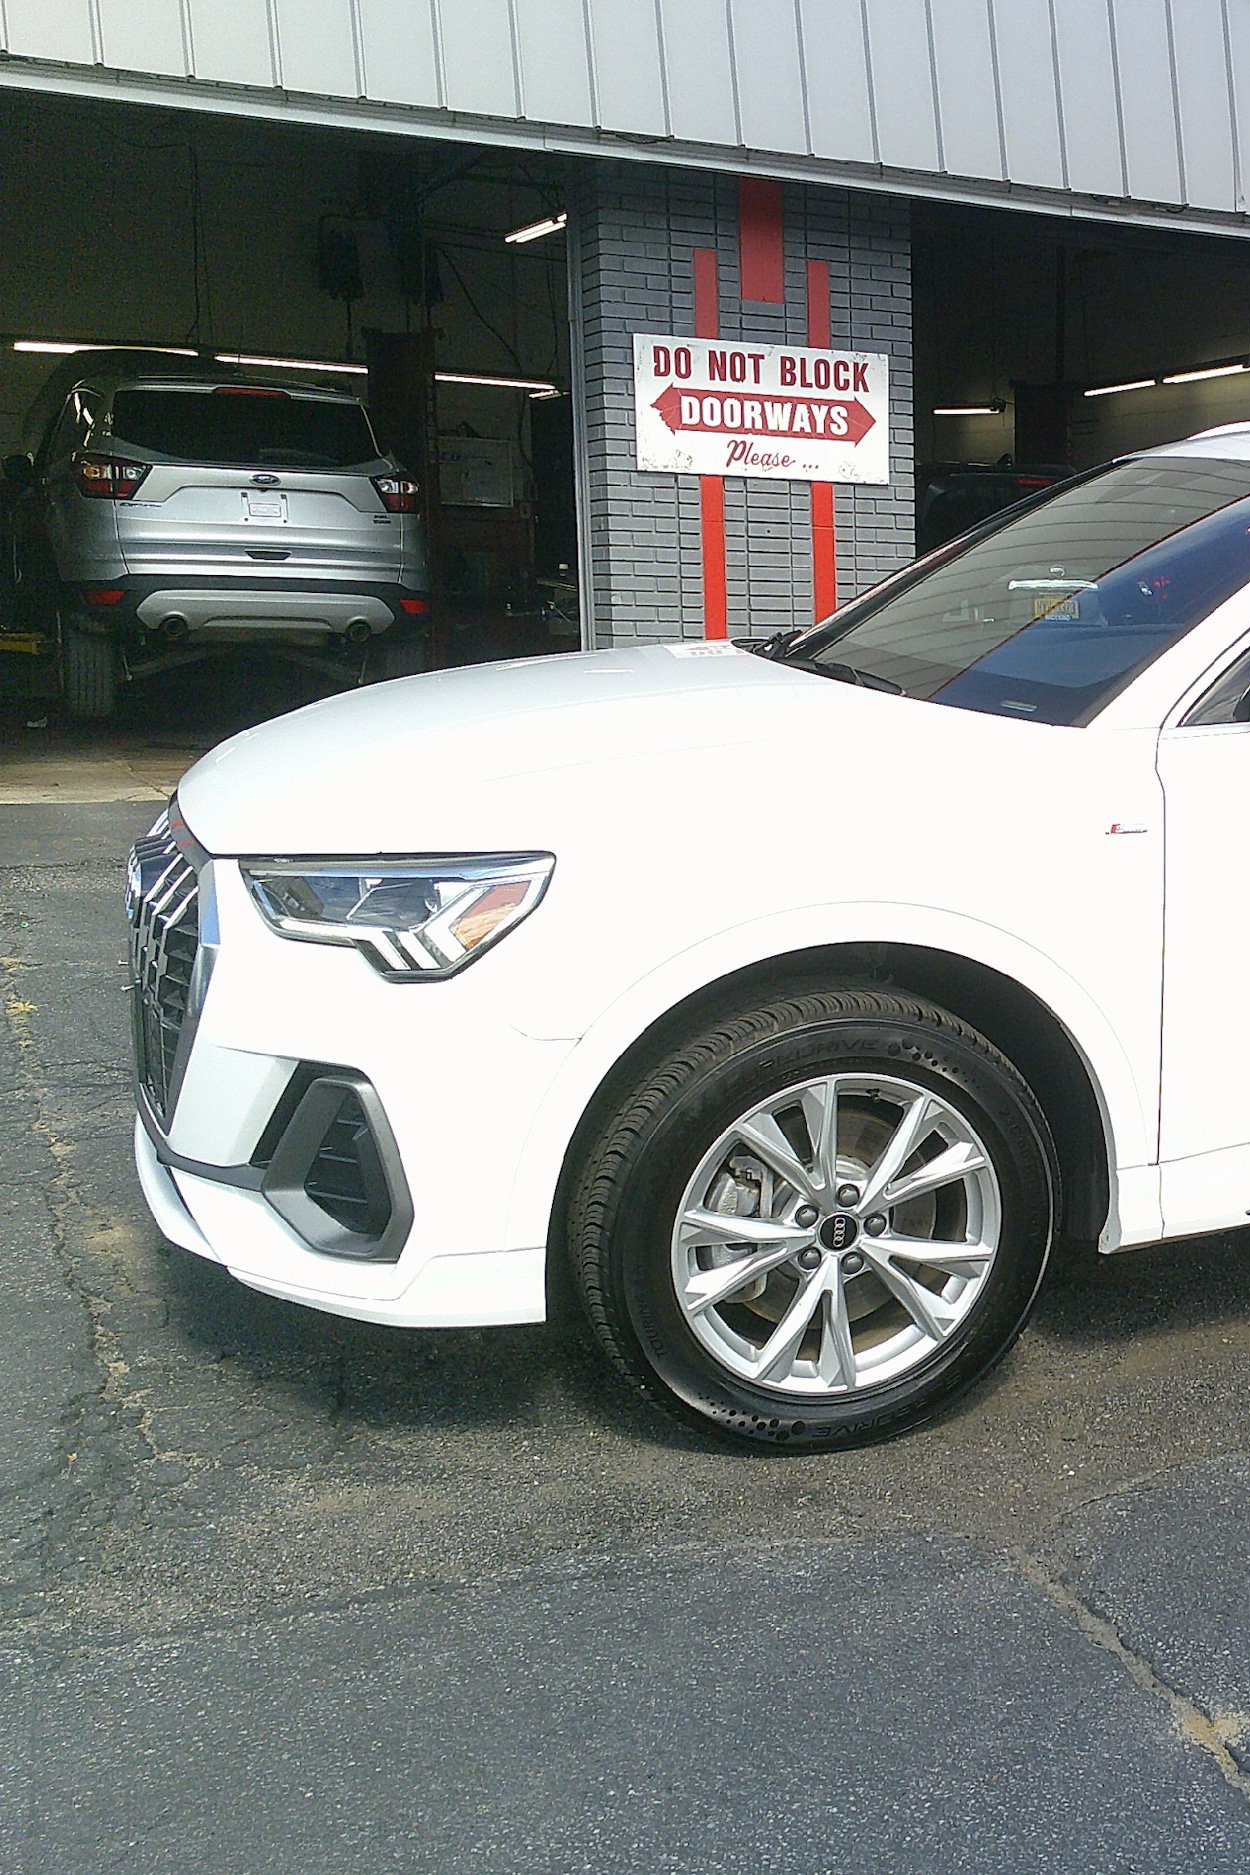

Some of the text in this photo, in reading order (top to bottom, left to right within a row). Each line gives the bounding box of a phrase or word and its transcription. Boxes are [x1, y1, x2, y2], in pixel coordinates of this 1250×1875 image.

[653, 345, 870, 393] DO NOT BLOCK
[680, 395, 849, 437] DOORWAYS
